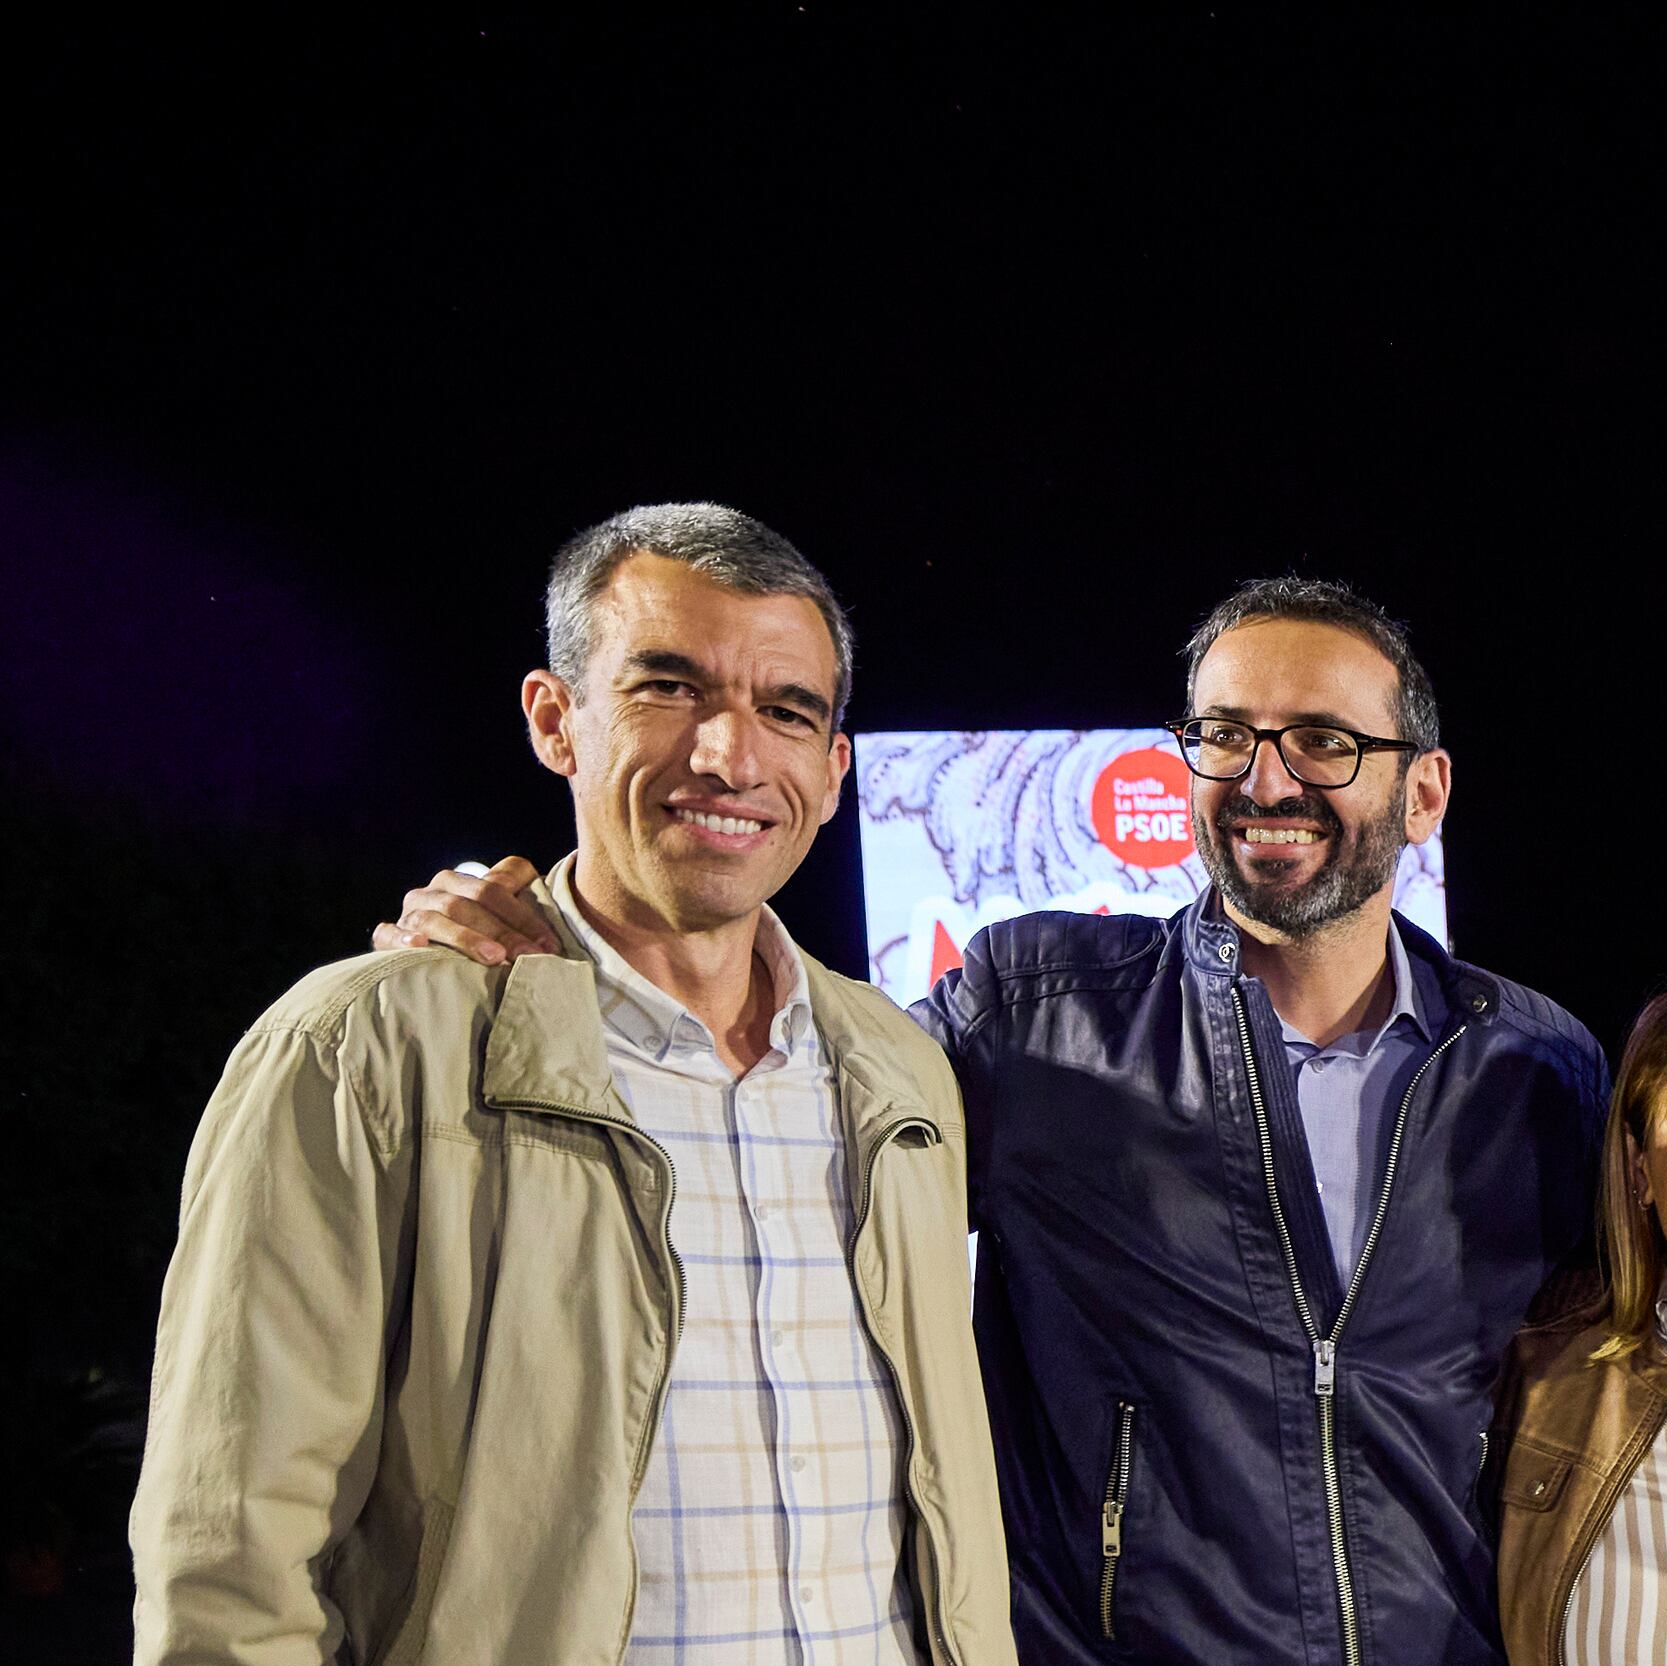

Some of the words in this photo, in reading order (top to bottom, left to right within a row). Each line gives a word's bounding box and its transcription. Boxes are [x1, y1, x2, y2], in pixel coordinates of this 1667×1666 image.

[1113, 778, 1164, 795] Castilla
[1114, 795, 1132, 812] La
[1133, 795, 1187, 811] Mancha
[1115, 813, 1189, 842] PSOE
